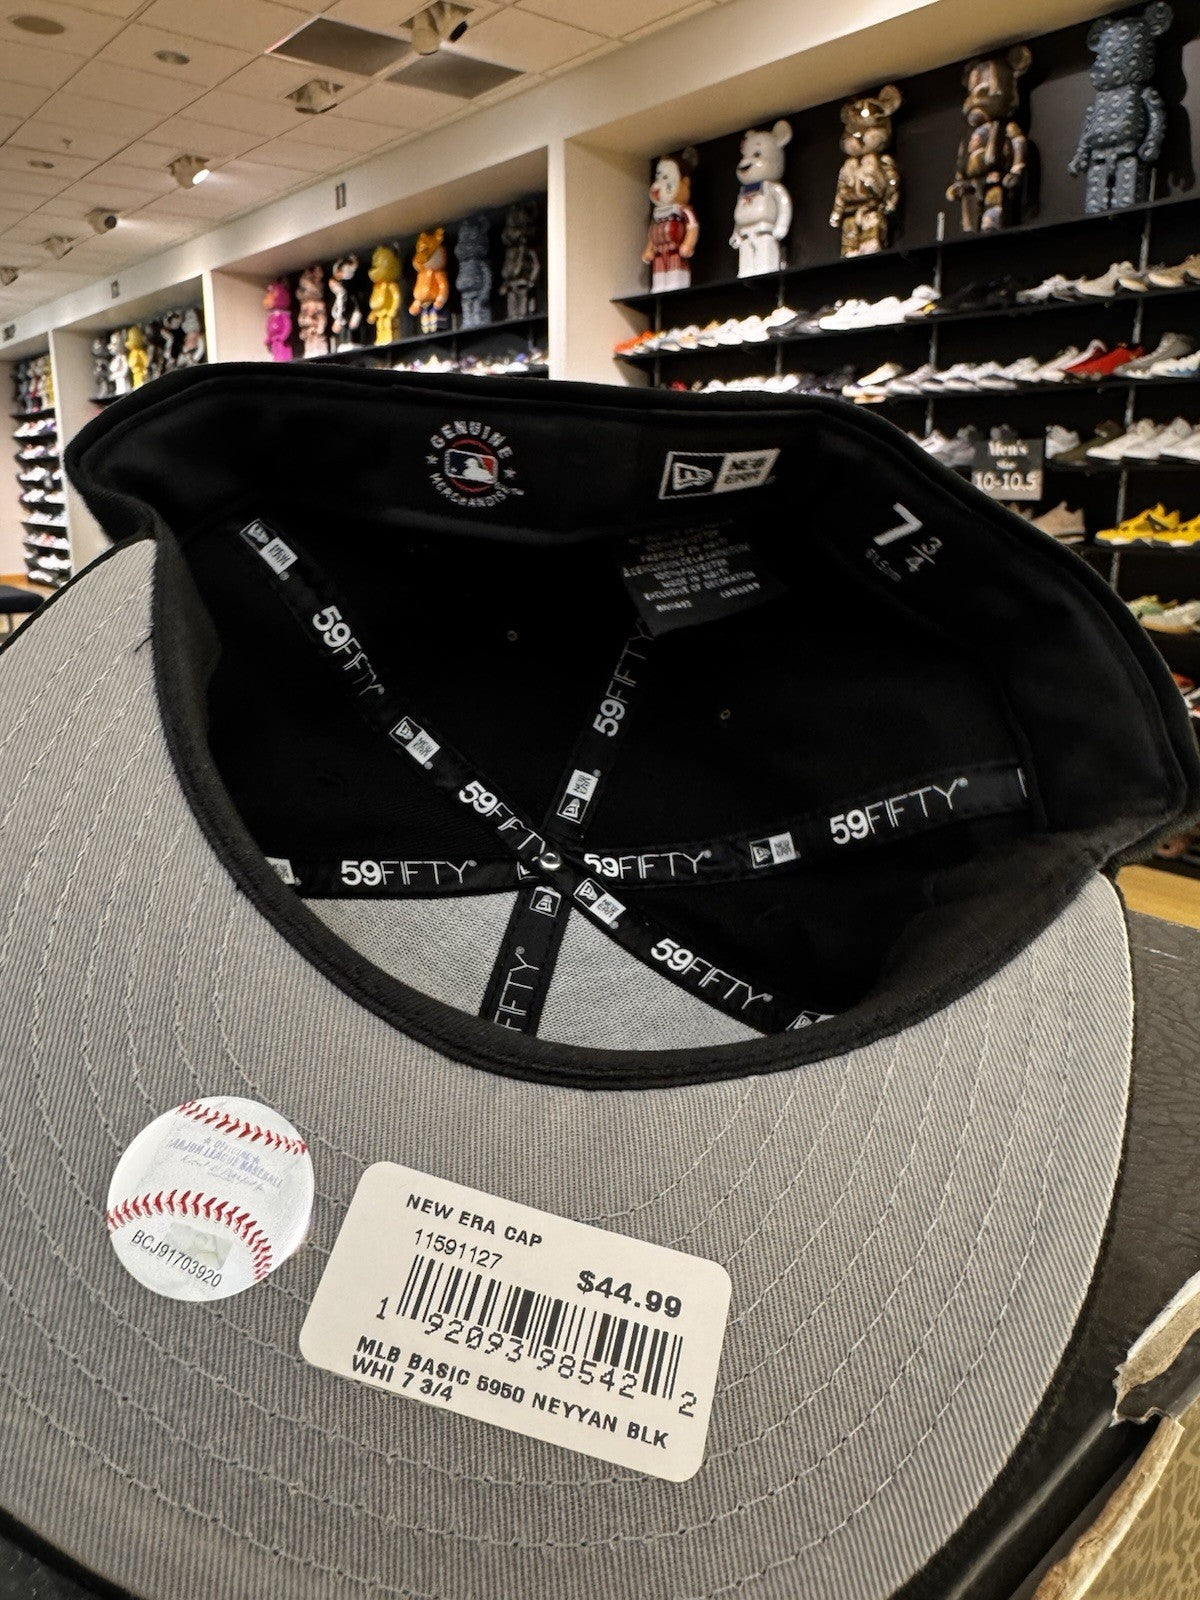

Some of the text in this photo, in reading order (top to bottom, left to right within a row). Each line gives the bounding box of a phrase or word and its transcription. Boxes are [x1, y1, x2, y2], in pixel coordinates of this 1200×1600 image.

[430, 420, 514, 460] GENUINE
[873, 502, 923, 546] 7
[312, 605, 382, 696] 59FIFTY
[593, 623, 654, 737] 59FIFTY
[830, 779, 958, 845] 59FIFTY
[341, 860, 469, 885] 59FIFTY
[584, 852, 704, 879] 59FIFTY
[650, 938, 769, 1010] 59FIFTY
[405, 1193, 543, 1248] NEW ERA CAP
[131, 1229, 222, 1288] BCJ91703920
[414, 1228, 503, 1270] 11591127
[576, 1269, 682, 1319] $44.99
[351, 1354, 453, 1402] WHI 7 3/4
[376, 1296, 697, 1418] 1 92093 98542 2
[357, 1335, 669, 1449] MLB BASIC 5950 NEYYAN BLK
